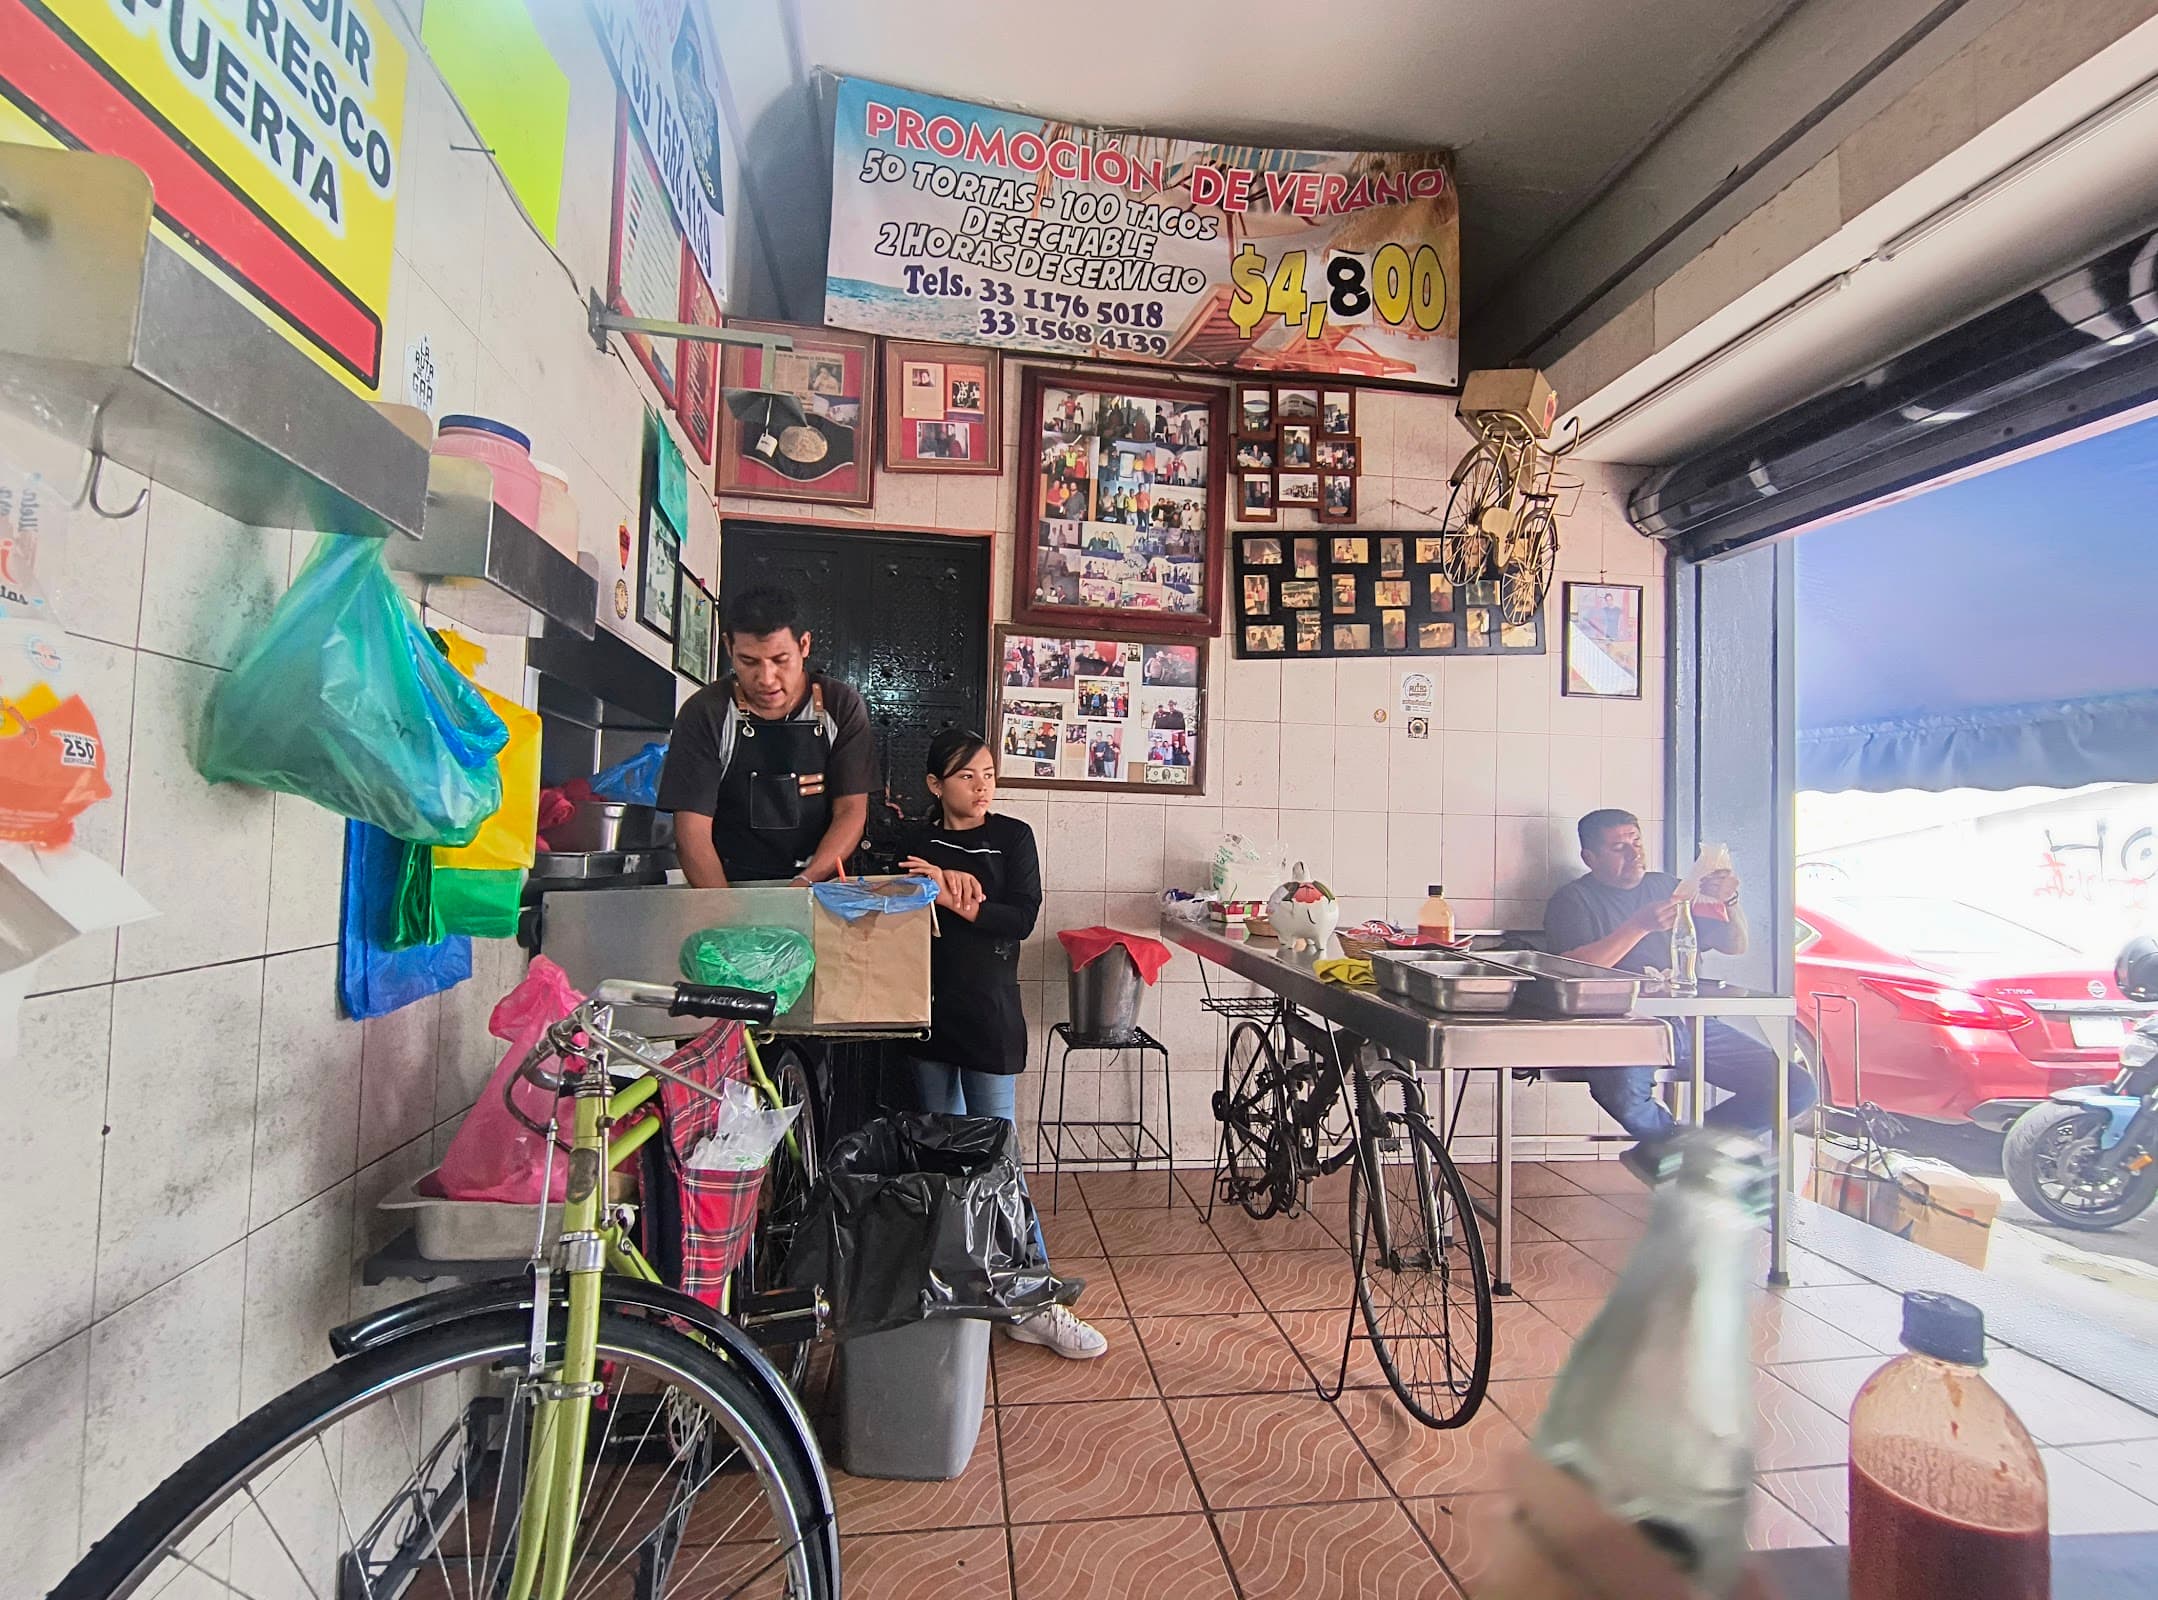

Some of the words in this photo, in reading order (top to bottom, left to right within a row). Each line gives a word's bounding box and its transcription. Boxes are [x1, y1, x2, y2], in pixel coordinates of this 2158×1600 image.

[656, 80, 684, 213] 1568
[686, 168, 712, 279] 4139
[859, 148, 906, 183] 50
[912, 161, 1038, 212] TORTAS
[1060, 190, 1121, 225] 100
[1126, 200, 1219, 240] TACOS
[866, 101, 1163, 194] PROMOCIÓN
[1190, 164, 1253, 213] DE
[1264, 168, 1445, 217] VERANO
[875, 222, 900, 256] 2
[900, 223, 1016, 272] HORAS
[1015, 249, 1062, 281] DE
[1060, 258, 1206, 294] SERVICIO
[960, 206, 1158, 260] DESECHABLE
[904, 265, 972, 297] Tels.
[979, 278, 1015, 306] 33
[1023, 288, 1089, 318] 1176
[1097, 301, 1164, 328] 5018
[1228, 243, 1447, 339] $4,800
[979, 308, 1016, 336] 33
[1024, 317, 1092, 344] 1568
[1100, 329, 1167, 355] 4139
[63, 738, 95, 760] 250
